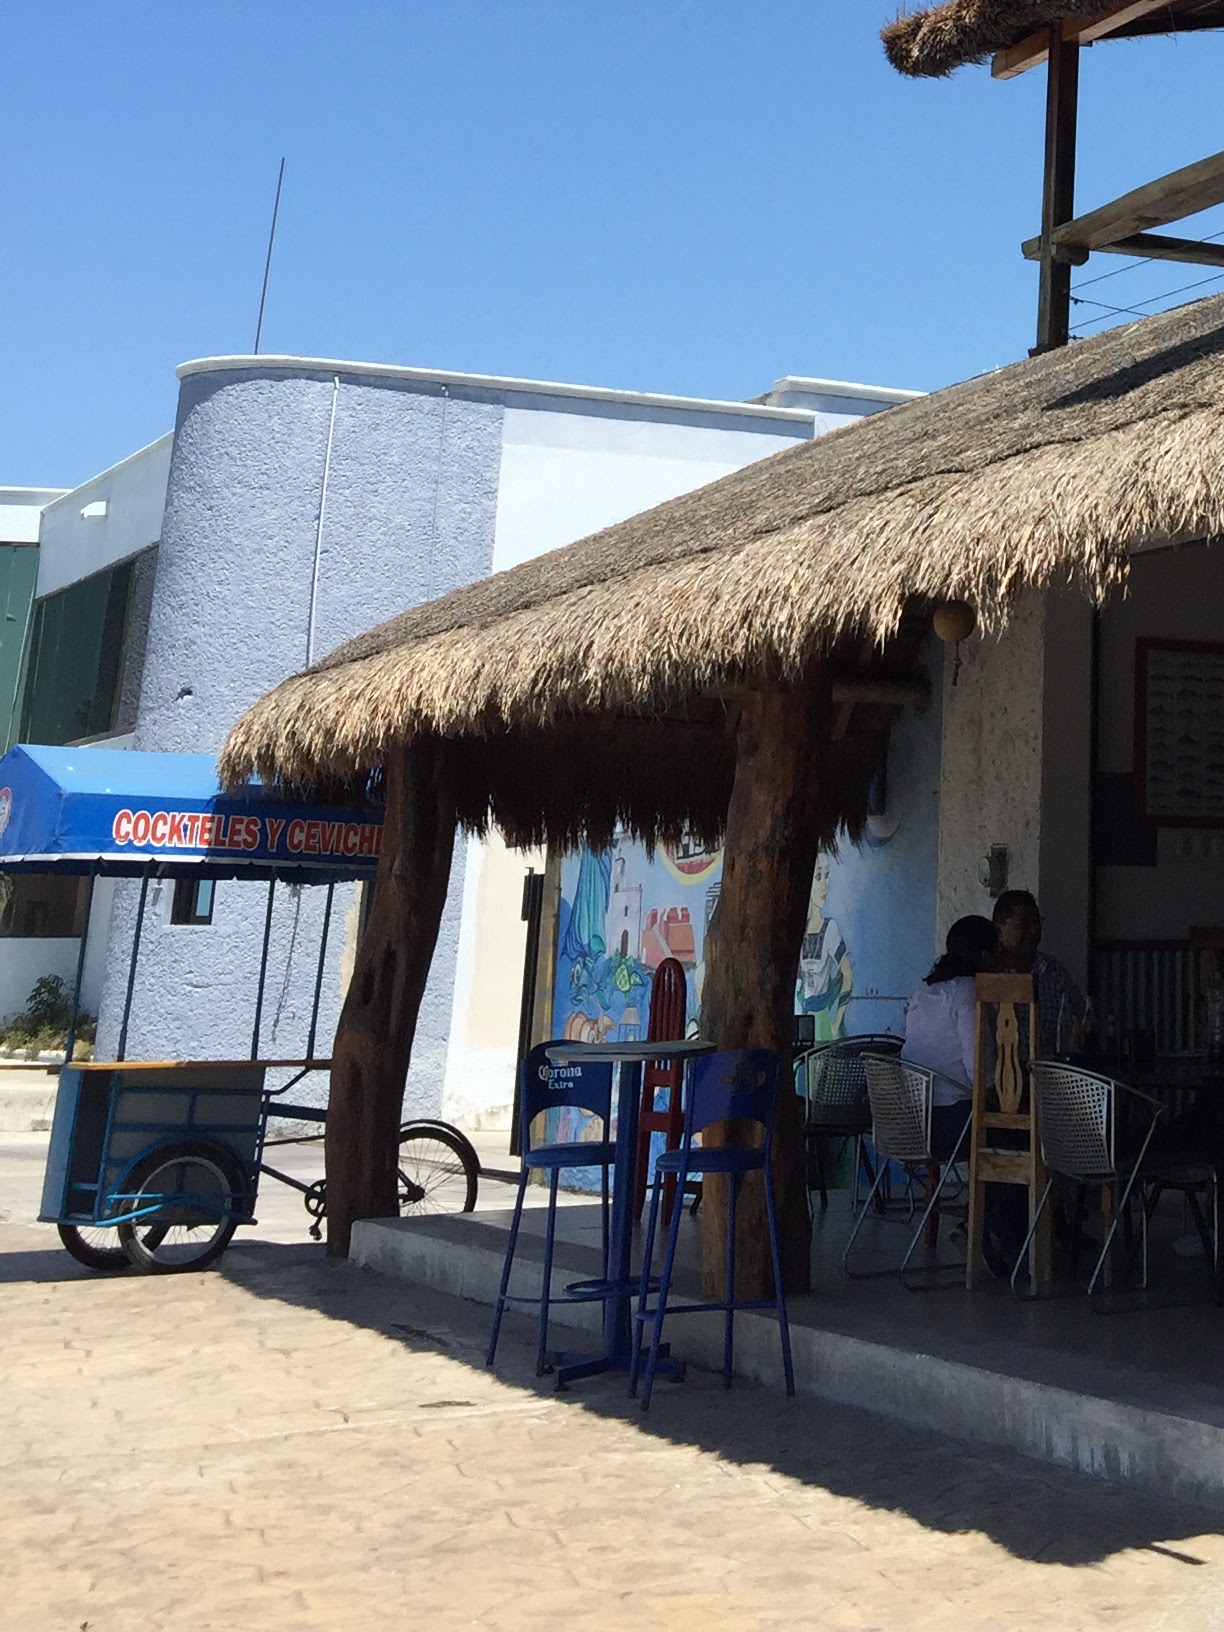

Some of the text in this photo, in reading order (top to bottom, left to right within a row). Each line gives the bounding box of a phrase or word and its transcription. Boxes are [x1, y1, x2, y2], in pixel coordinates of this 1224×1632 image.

[113, 809, 383, 857] COCKTELES Y CEVICH
[538, 1065, 582, 1081] Corona
